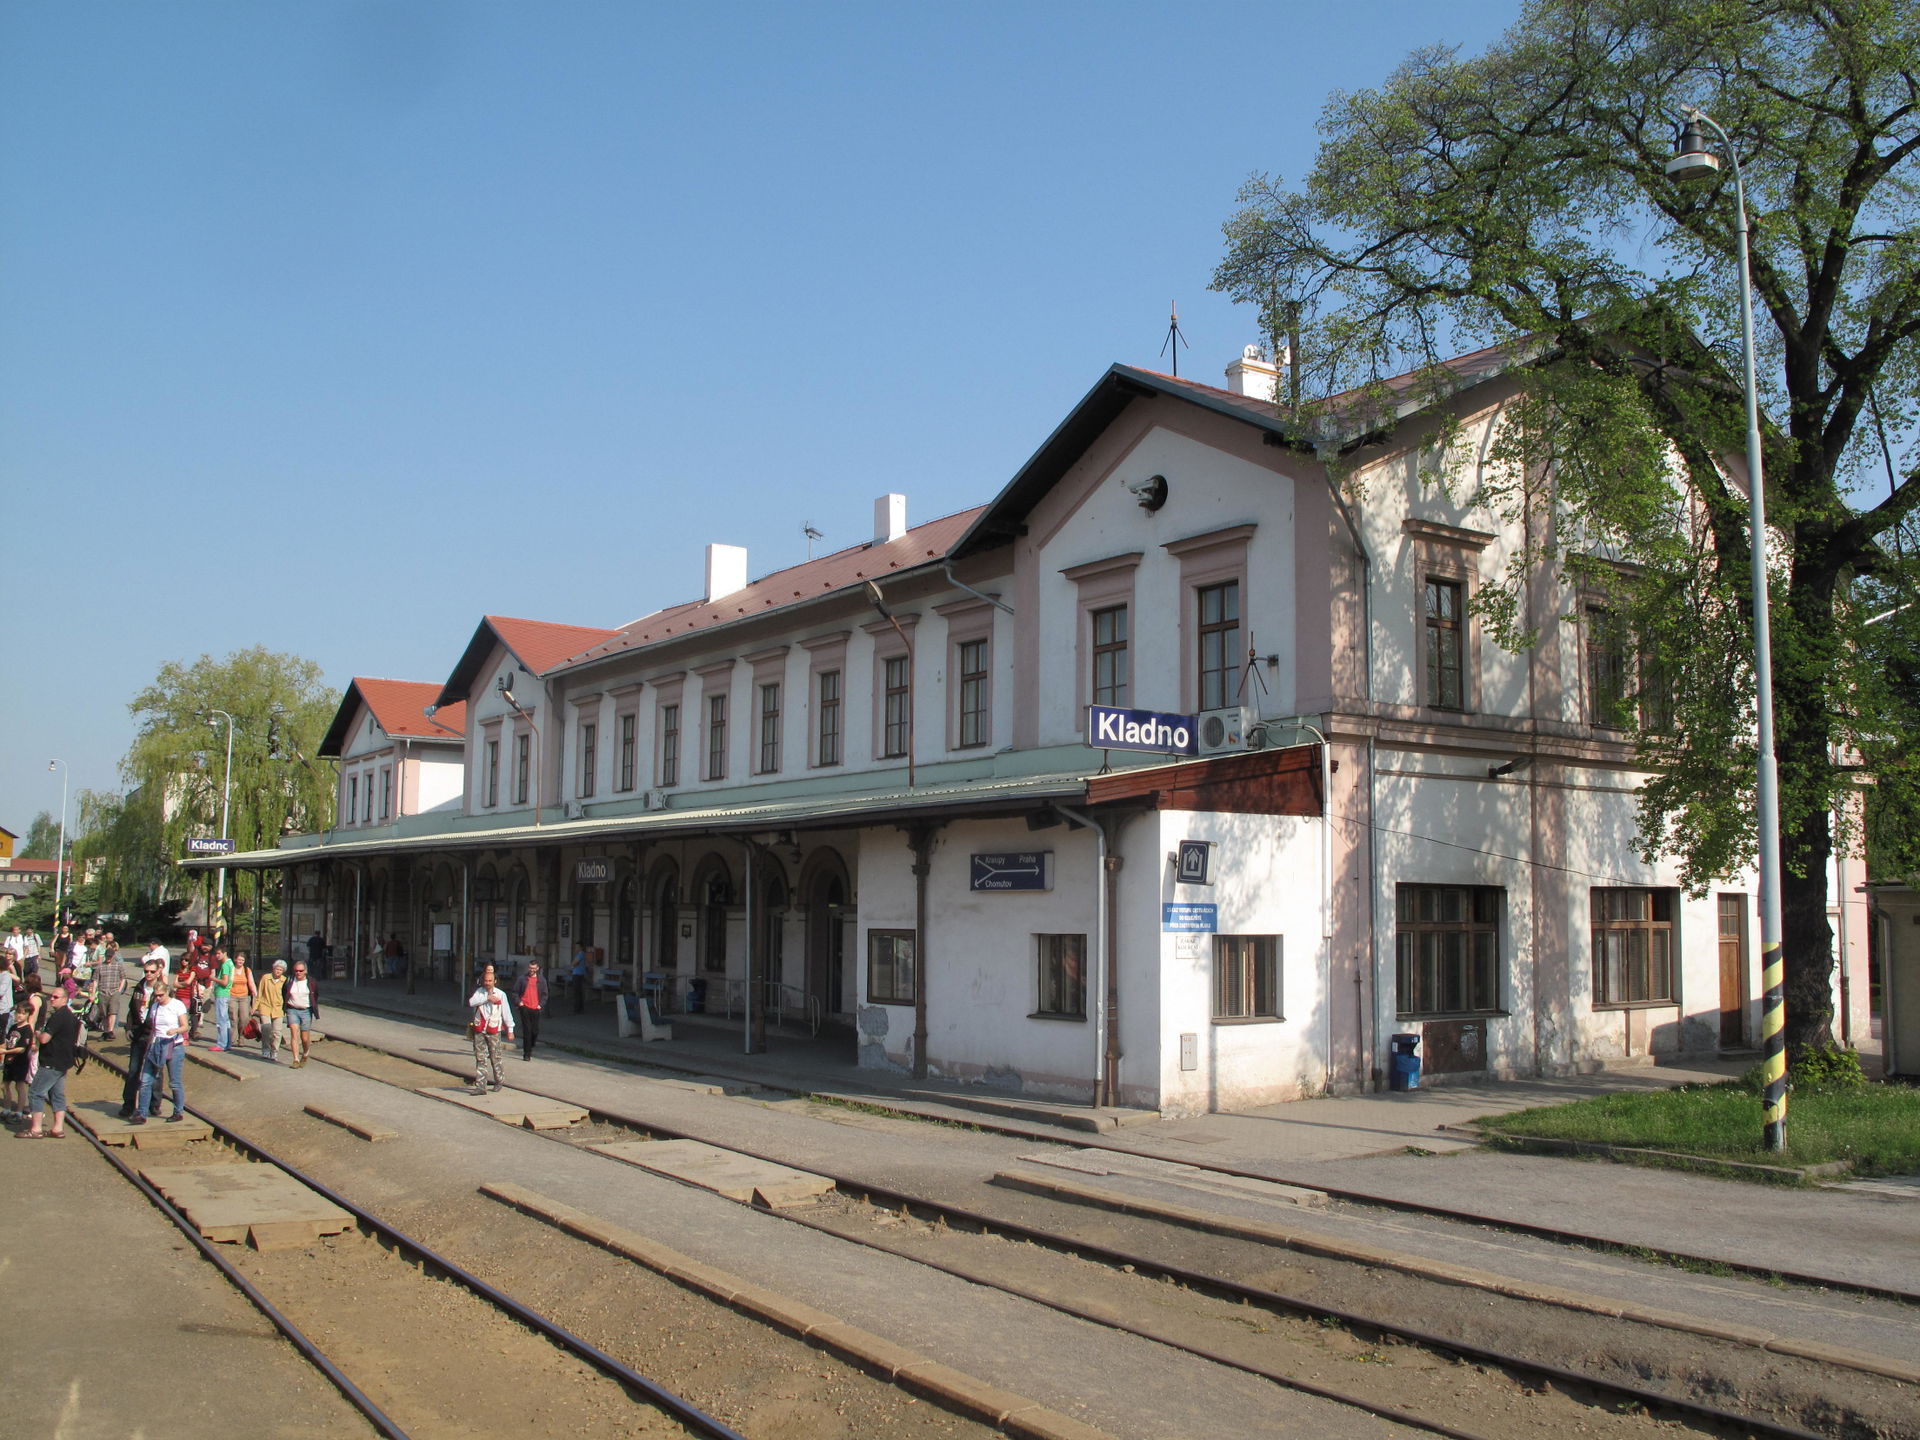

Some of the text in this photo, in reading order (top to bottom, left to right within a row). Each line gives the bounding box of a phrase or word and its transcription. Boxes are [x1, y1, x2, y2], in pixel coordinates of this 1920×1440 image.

[1098, 712, 1189, 748] Kladno
[1019, 855, 1036, 864] Praha
[578, 860, 606, 878] Kladno
[985, 880, 1012, 888] Chomutov
